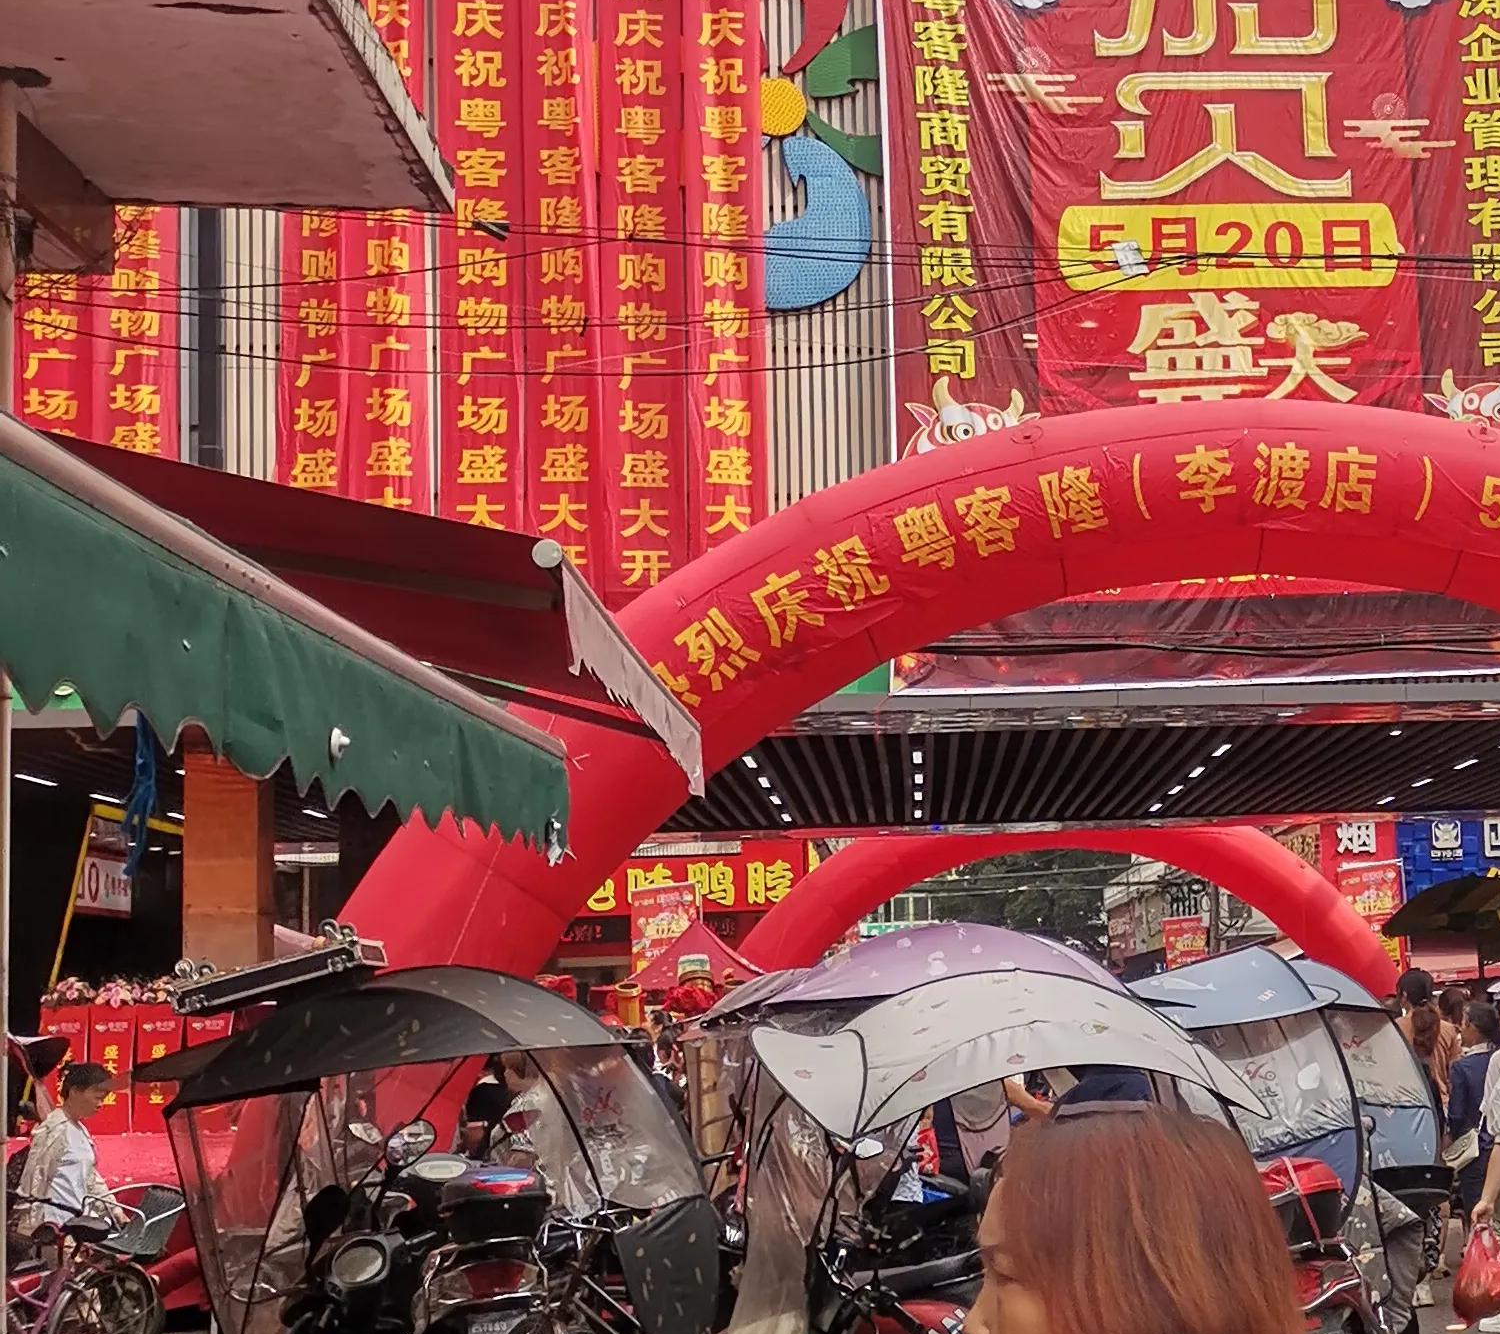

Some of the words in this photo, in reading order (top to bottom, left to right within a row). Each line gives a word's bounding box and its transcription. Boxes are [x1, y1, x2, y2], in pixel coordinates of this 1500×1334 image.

[1088, 216, 1372, 273] 5月20日
[1127, 291, 1371, 404] 盛大
[1336, 821, 1377, 854] 烟
[586, 859, 796, 912] 味鸭脖
